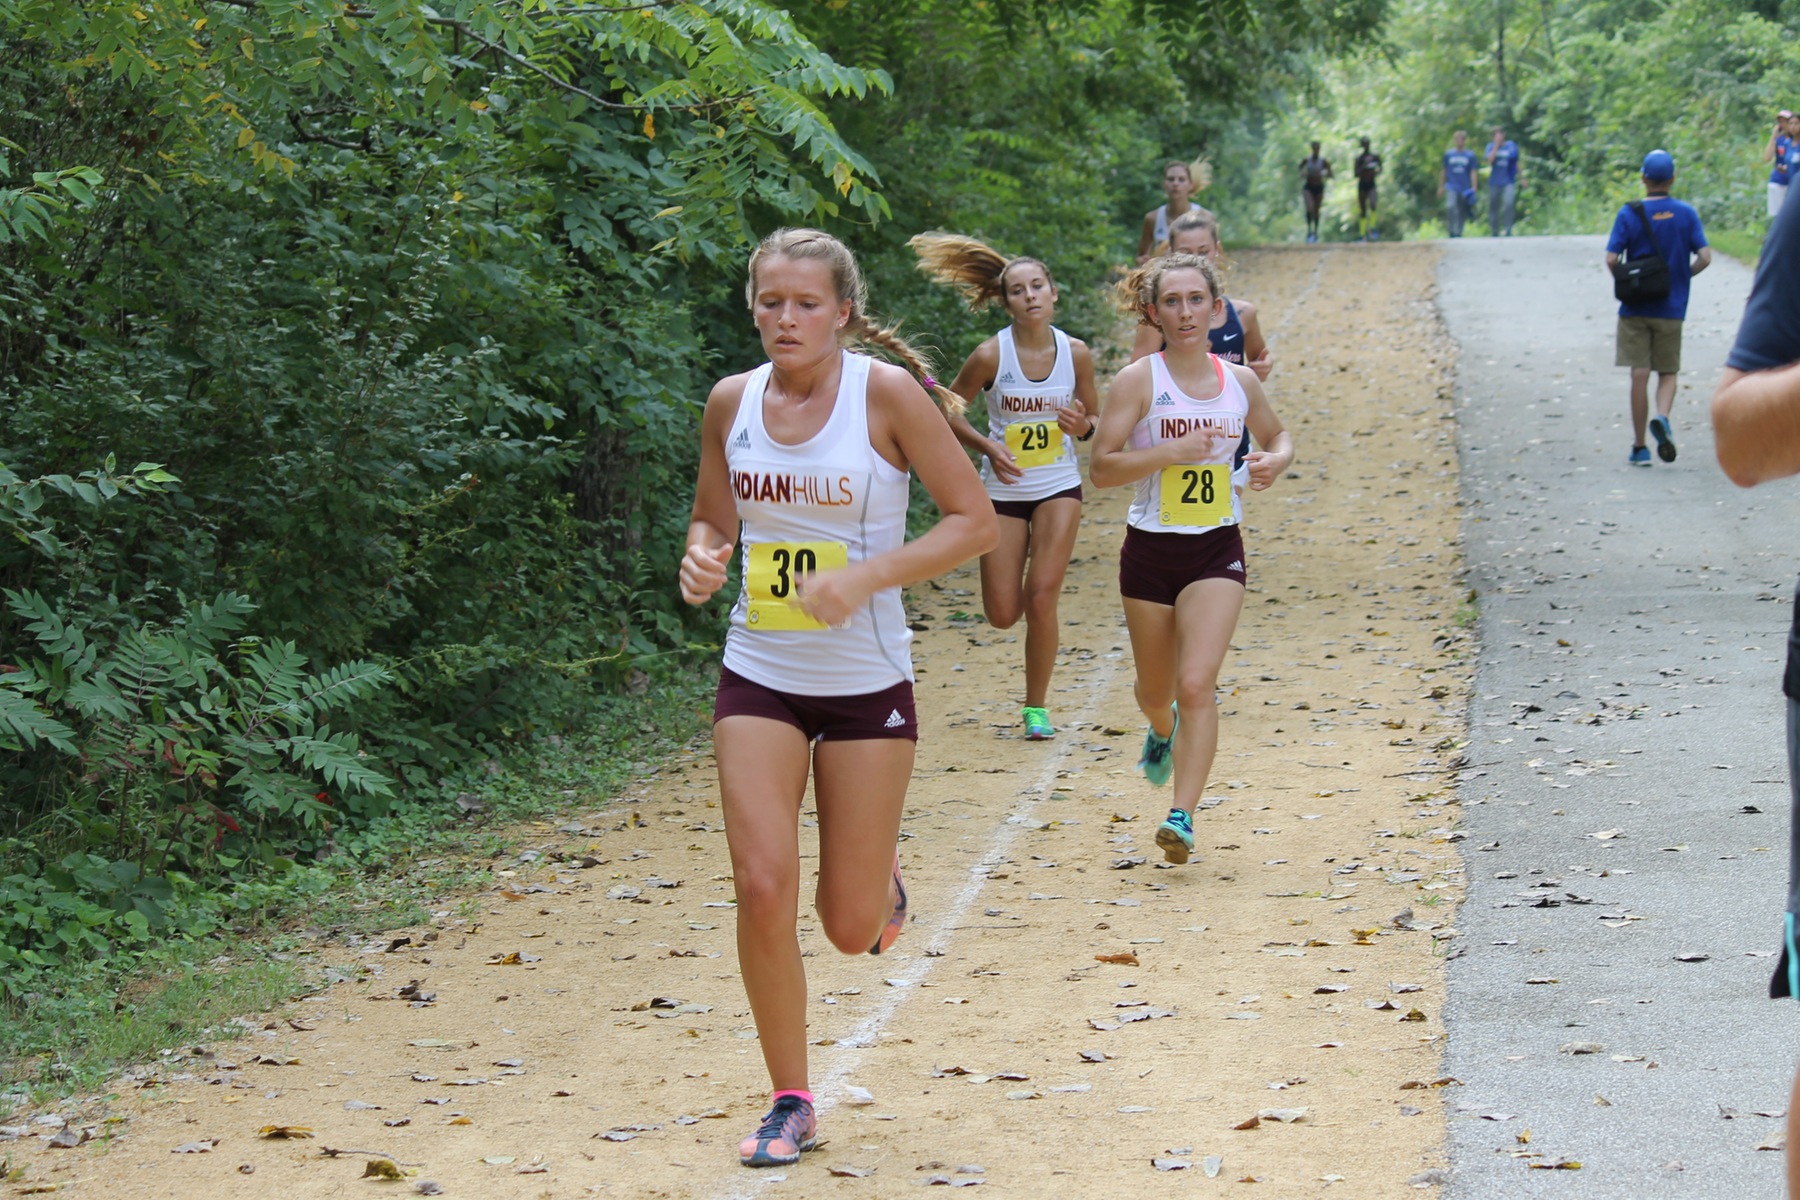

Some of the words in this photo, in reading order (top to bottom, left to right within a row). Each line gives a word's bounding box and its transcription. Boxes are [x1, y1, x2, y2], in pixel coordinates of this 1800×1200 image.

[1020, 424, 1049, 451] 29
[732, 469, 853, 506] NDIANHILLS
[1181, 469, 1215, 504] 28
[770, 548, 816, 599] 30
